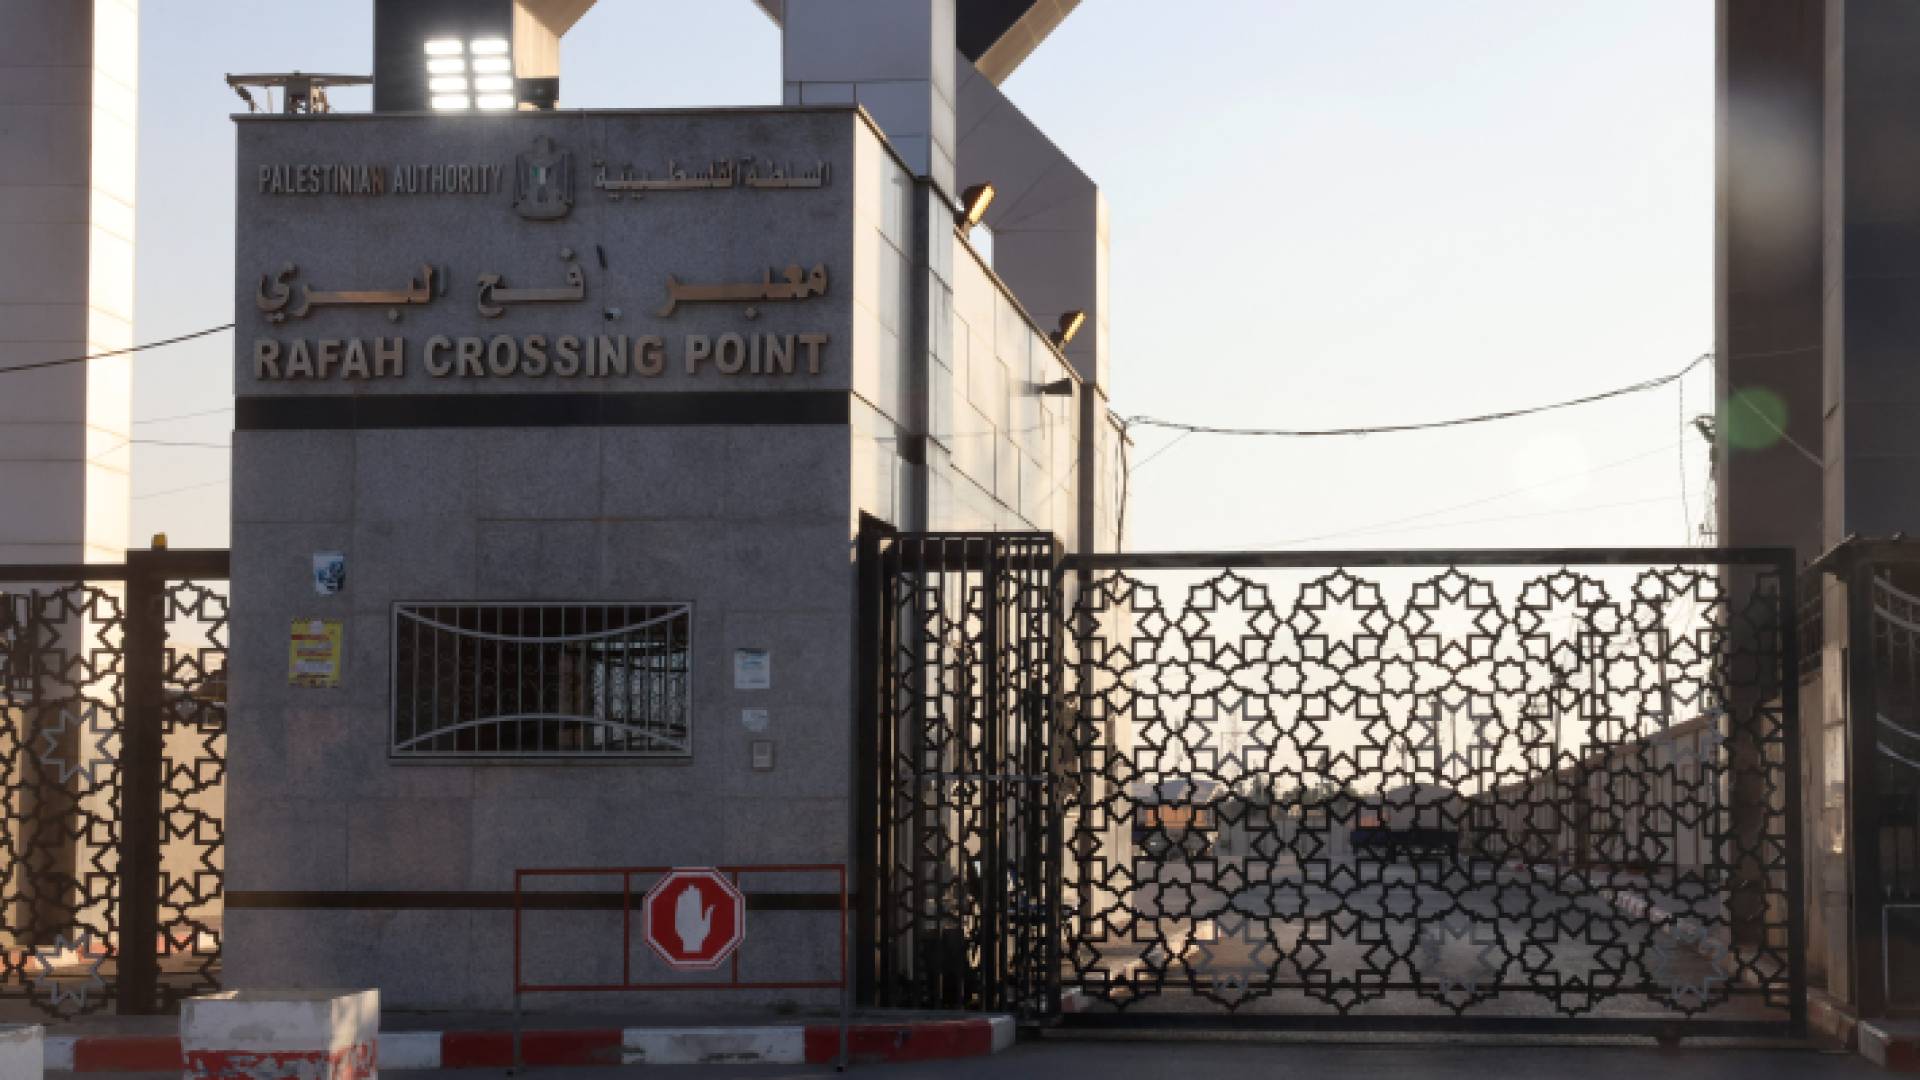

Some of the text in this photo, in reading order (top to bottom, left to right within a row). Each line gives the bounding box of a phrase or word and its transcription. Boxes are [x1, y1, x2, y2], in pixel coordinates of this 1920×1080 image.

[258, 163, 502, 194] PALESTINIAN AUTHORITY
[592, 155, 741, 201] الفلسطينية
[255, 261, 449, 324] البري
[656, 262, 829, 319] معبر
[255, 332, 830, 379] RAFAH CROSSING POINT
